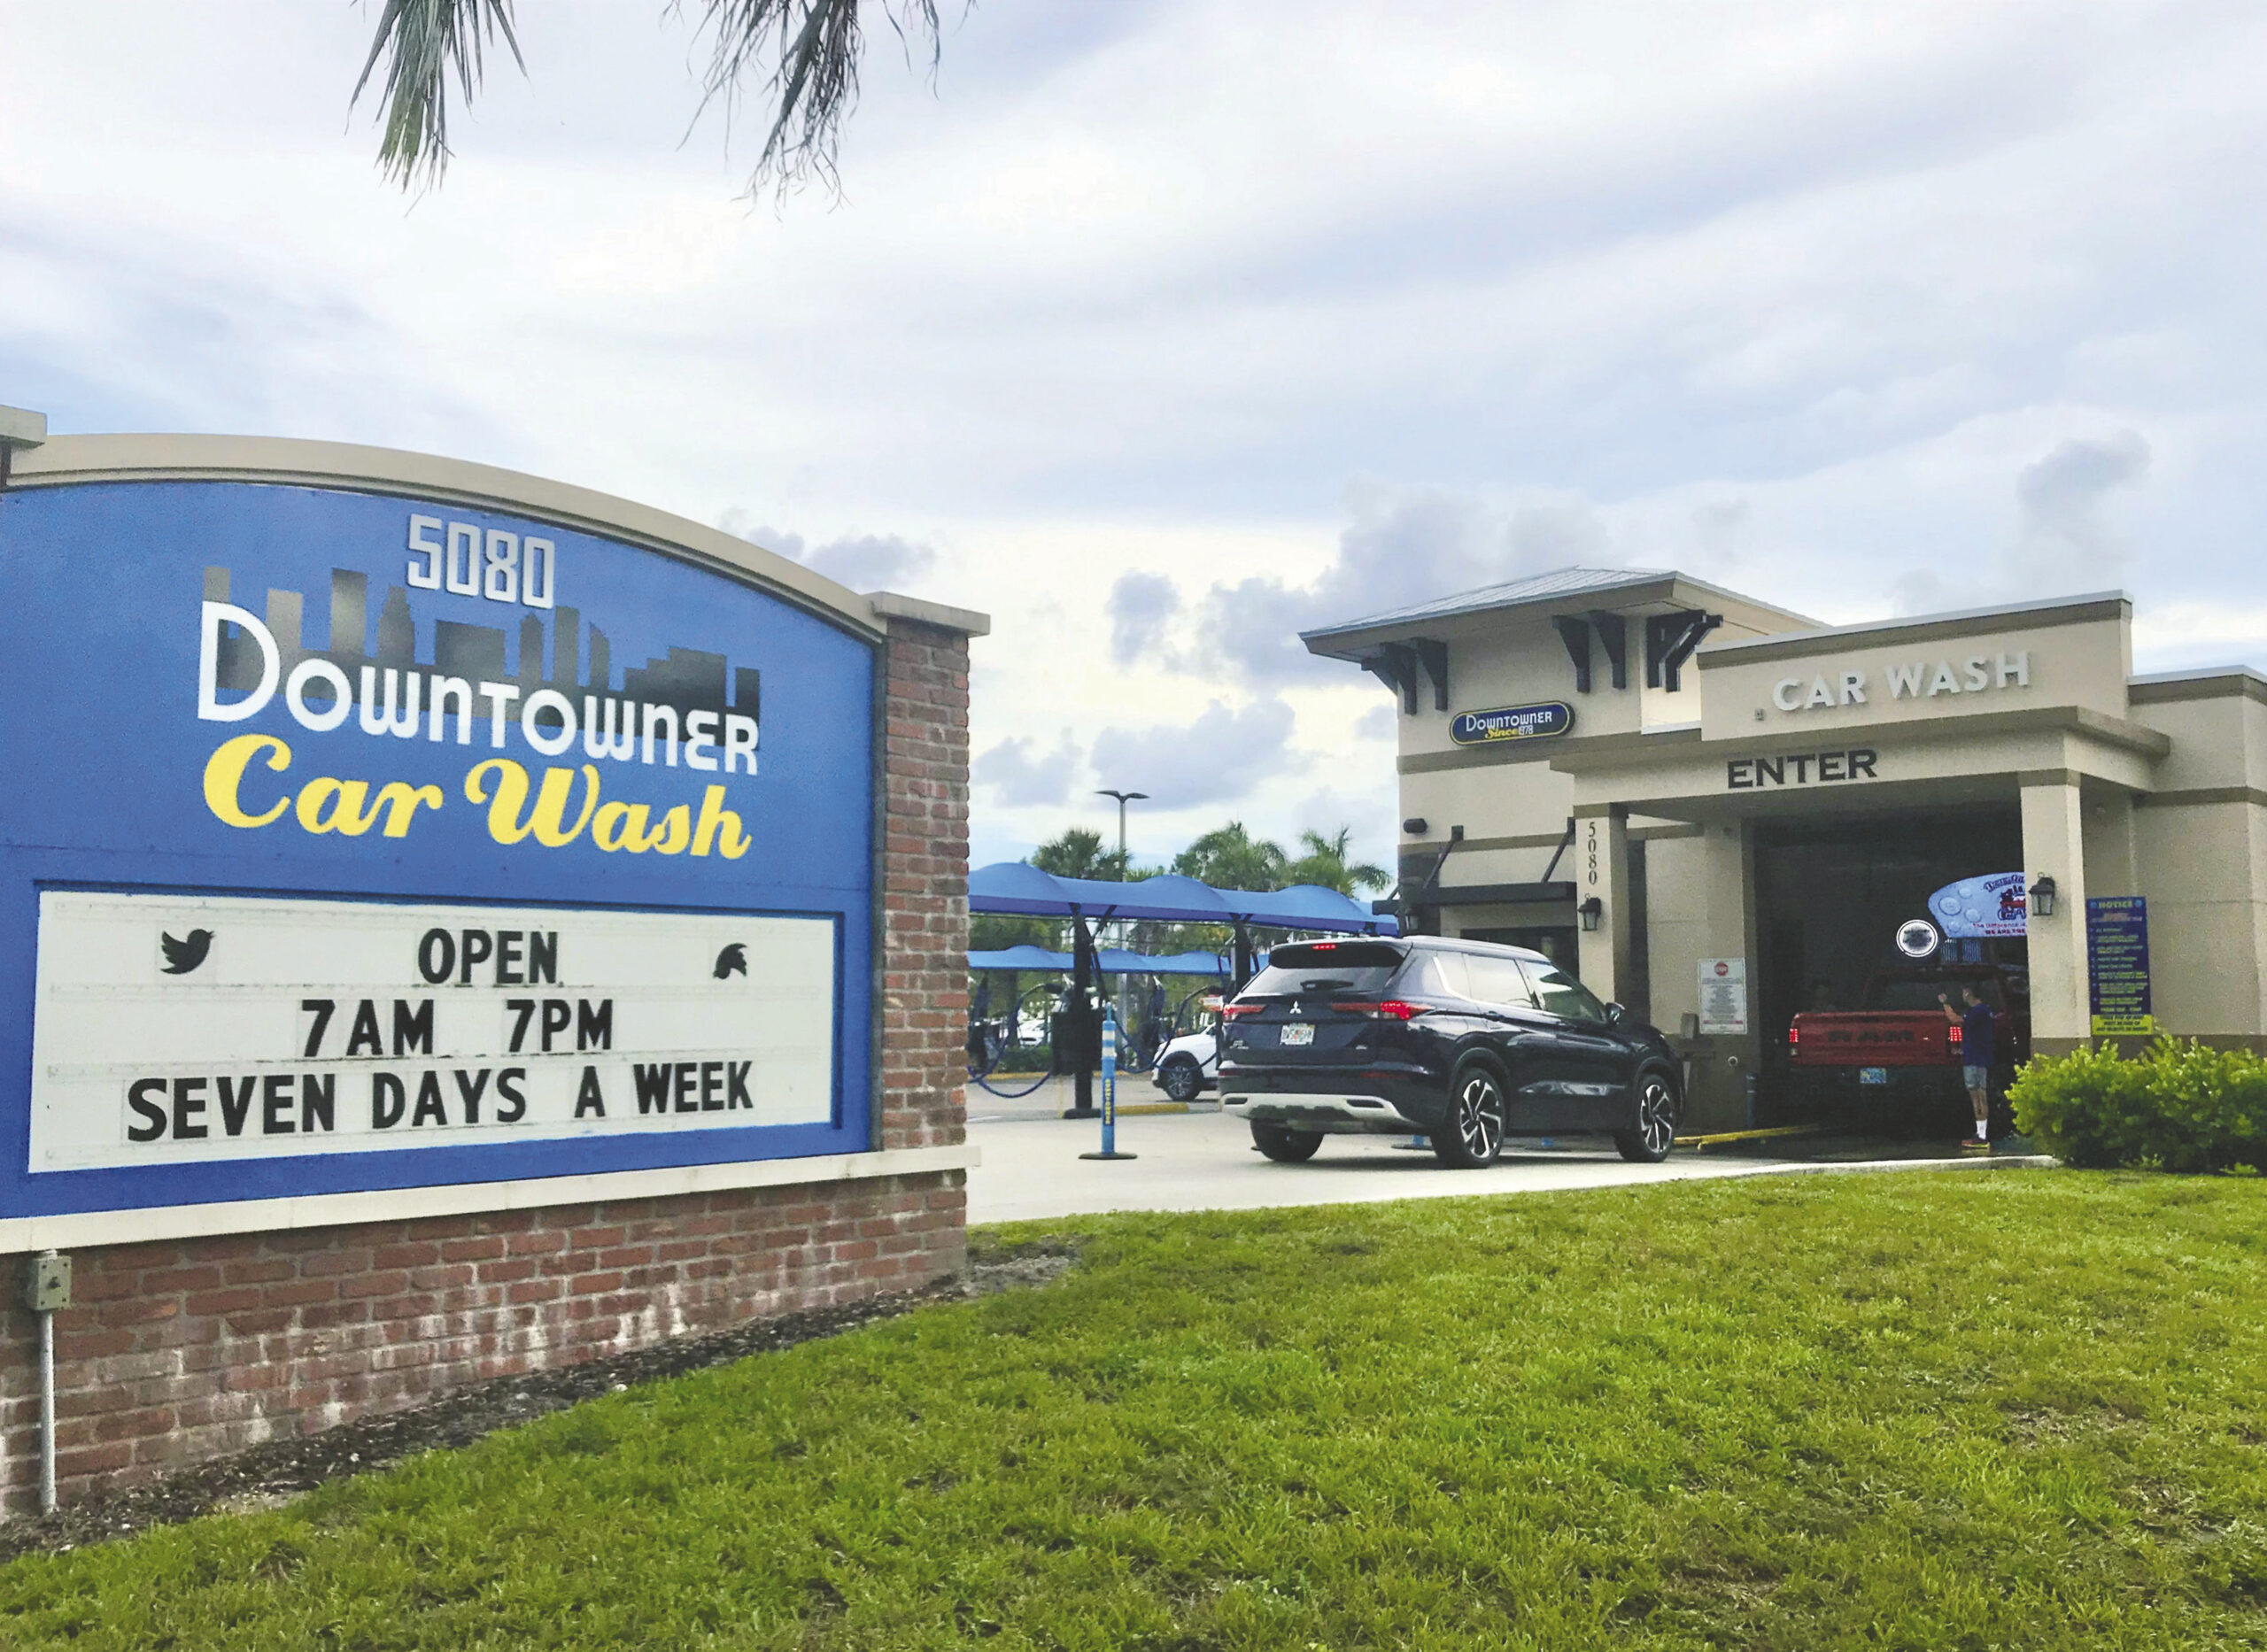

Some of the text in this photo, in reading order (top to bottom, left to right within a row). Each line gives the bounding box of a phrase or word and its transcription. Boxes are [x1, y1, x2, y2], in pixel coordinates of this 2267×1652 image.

[407, 513, 554, 608] 5080
[1773, 650, 2031, 712] CAR WASH
[1484, 725, 1534, 739] Since 1978
[203, 733, 753, 860] Car Wash
[1728, 749, 1878, 789] ENTER
[1588, 822, 1598, 885] 5080
[418, 928, 559, 984] OPEN
[506, 999, 614, 1054] 7PM
[128, 1060, 754, 1142] SEVEN DAYS A WEEK
